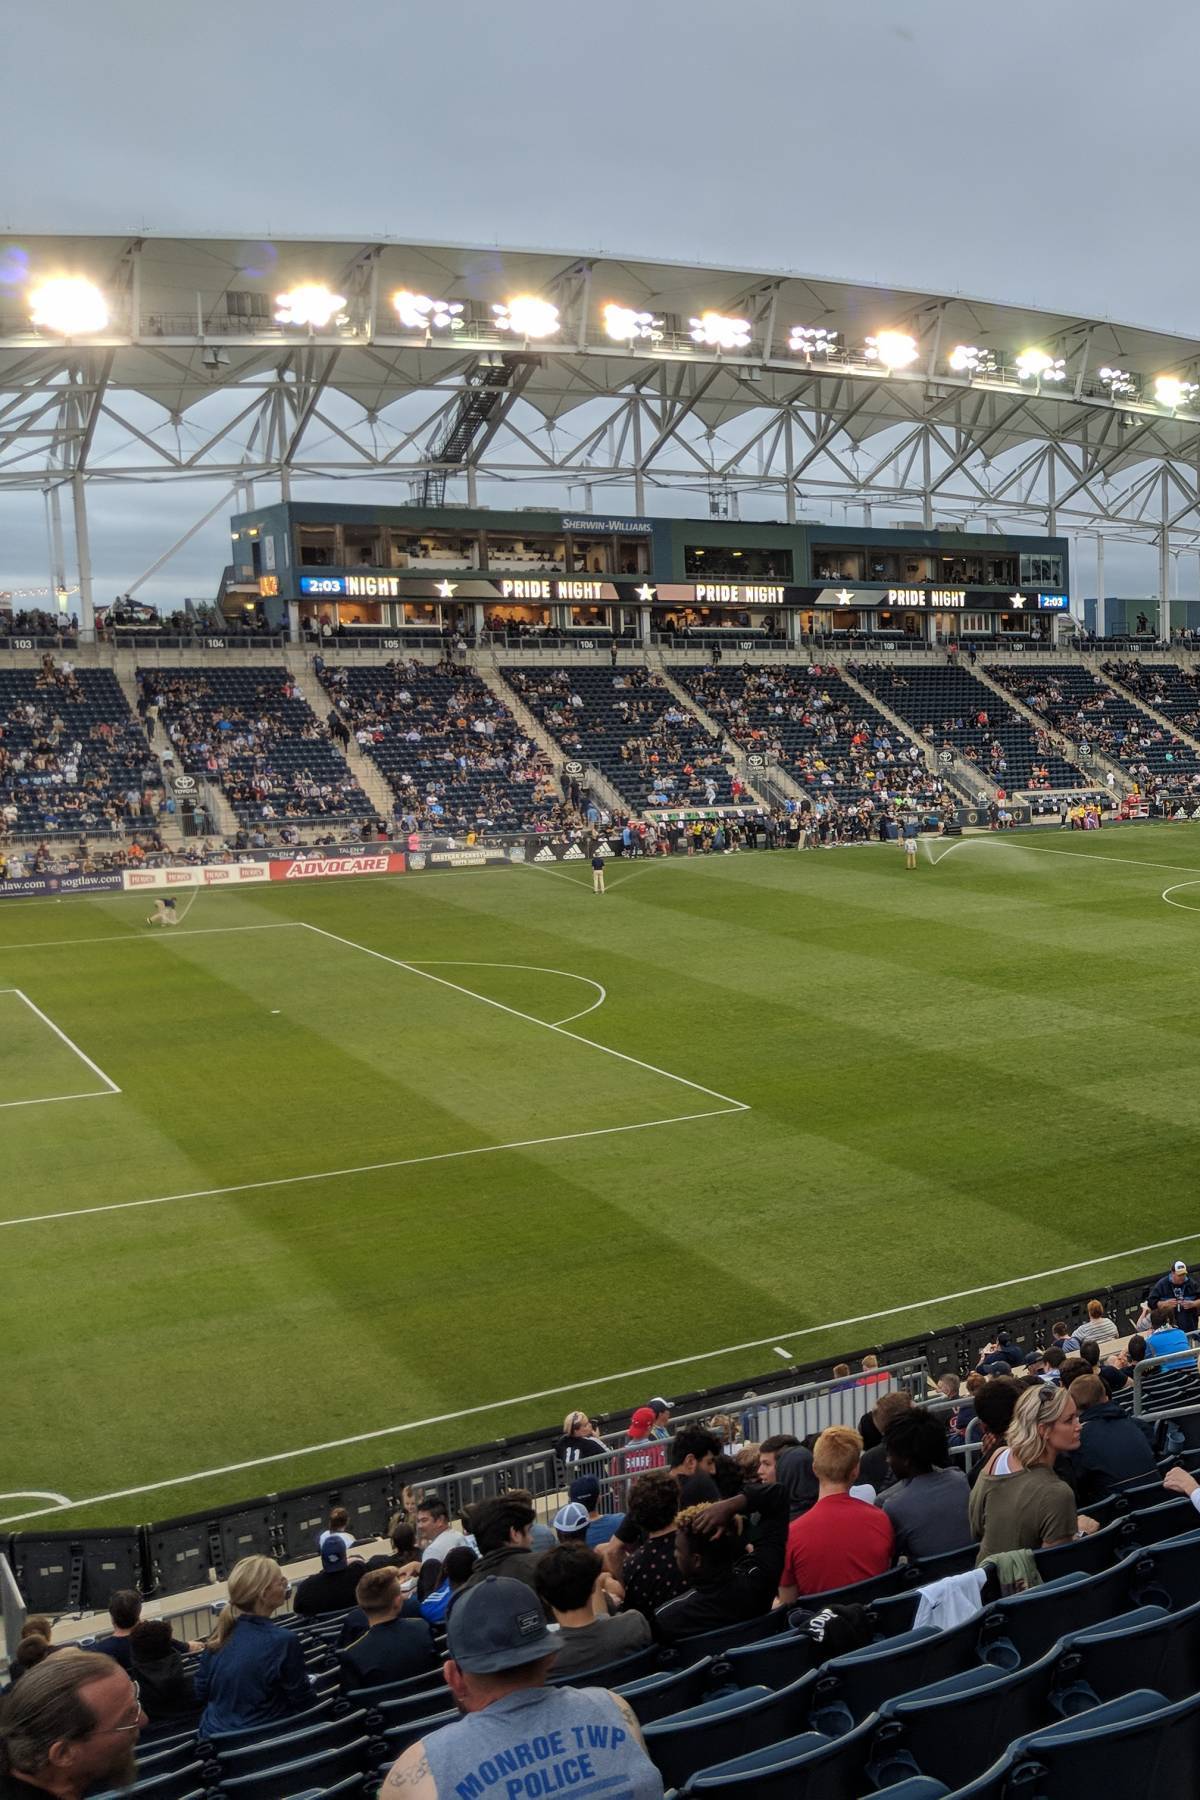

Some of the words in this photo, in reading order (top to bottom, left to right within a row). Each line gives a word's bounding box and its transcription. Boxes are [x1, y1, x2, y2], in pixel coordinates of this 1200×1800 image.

[309, 580, 341, 592] 2:03
[349, 576, 400, 596] NIGHT
[502, 580, 550, 598] PRIDE
[558, 581, 602, 600] NIGHT
[696, 584, 739, 602] PRIDE
[745, 586, 785, 604] NIGHT
[888, 589, 926, 606] PRIDE
[931, 591, 966, 607] NIGHT
[1043, 597, 1063, 607] 2:03
[14, 639, 32, 649] 103
[207, 639, 224, 648] 104
[383, 640, 399, 649] 105
[580, 640, 594, 649] 106
[740, 641, 753, 650] 107
[287, 859, 388, 877] ADVOCARE
[61, 874, 121, 888] sogtlaw.com
[455, 1730, 568, 1800] MONROE
[571, 1724, 627, 1750] TWP
[506, 1753, 596, 1800] POLICE
